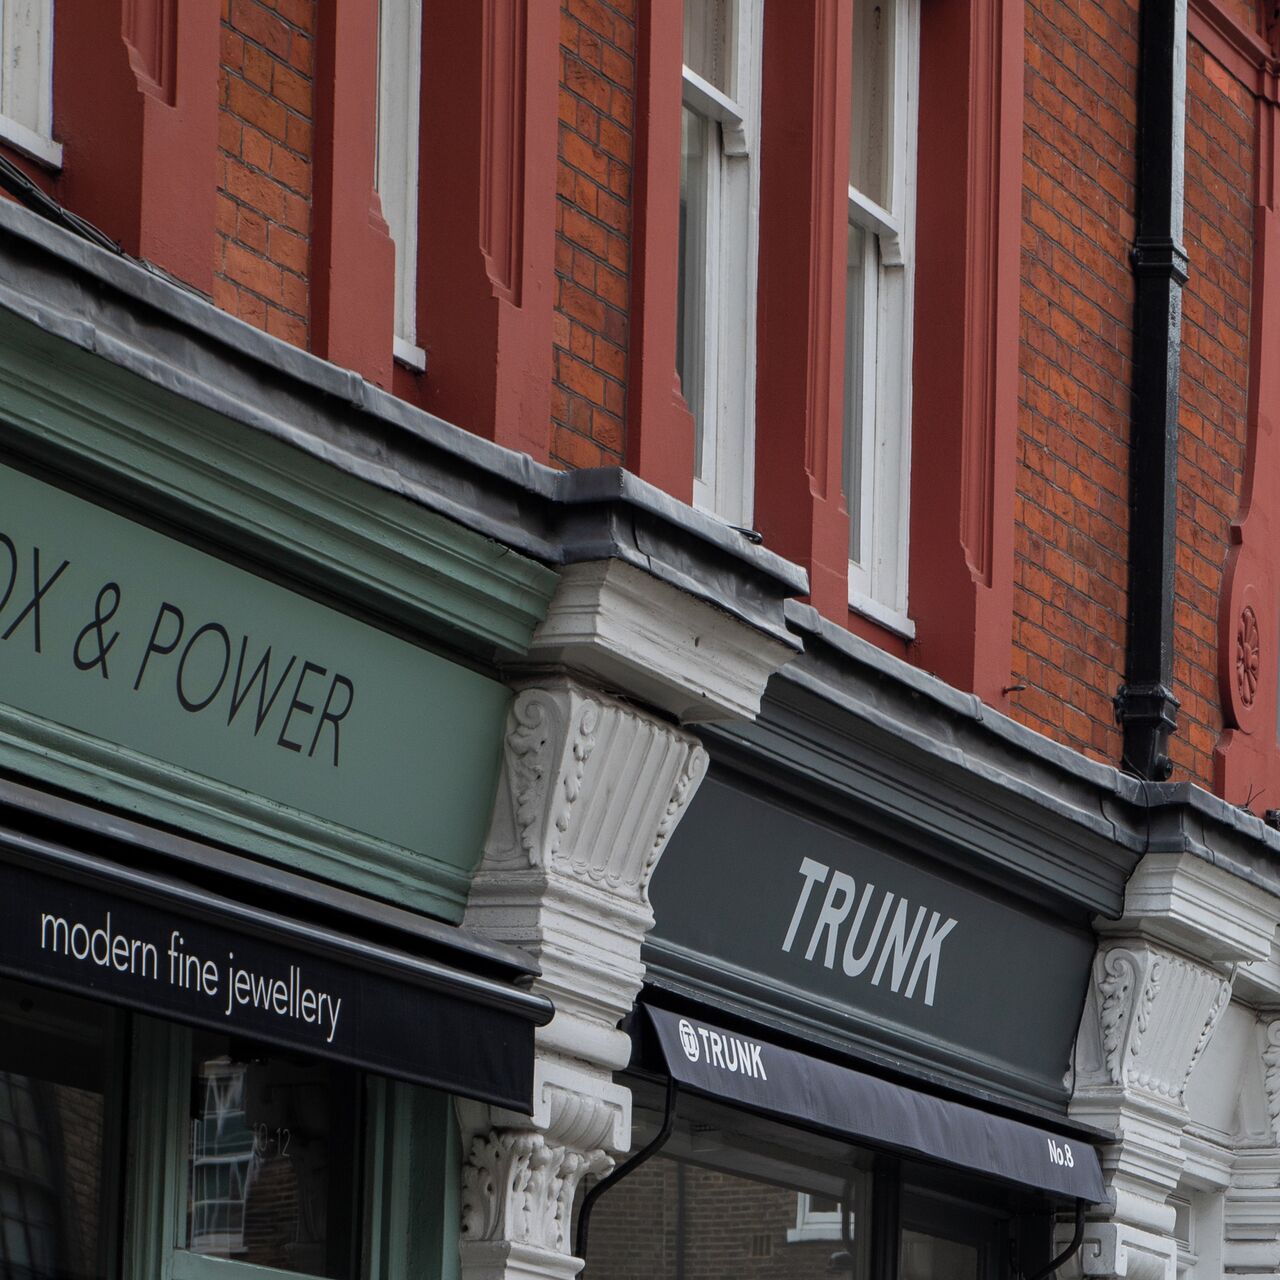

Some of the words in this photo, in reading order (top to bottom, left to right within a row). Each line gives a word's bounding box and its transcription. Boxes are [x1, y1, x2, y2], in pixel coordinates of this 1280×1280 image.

[0, 532, 70, 654] X
[73, 582, 121, 680] &
[133, 601, 354, 767] POWER
[41, 911, 158, 980] modern
[168, 930, 218, 996] fine
[225, 952, 341, 1043] jewellery
[781, 856, 958, 1006] TRUNK
[697, 1027, 768, 1081] TRUNK
[1047, 1138, 1074, 1169] No.8
